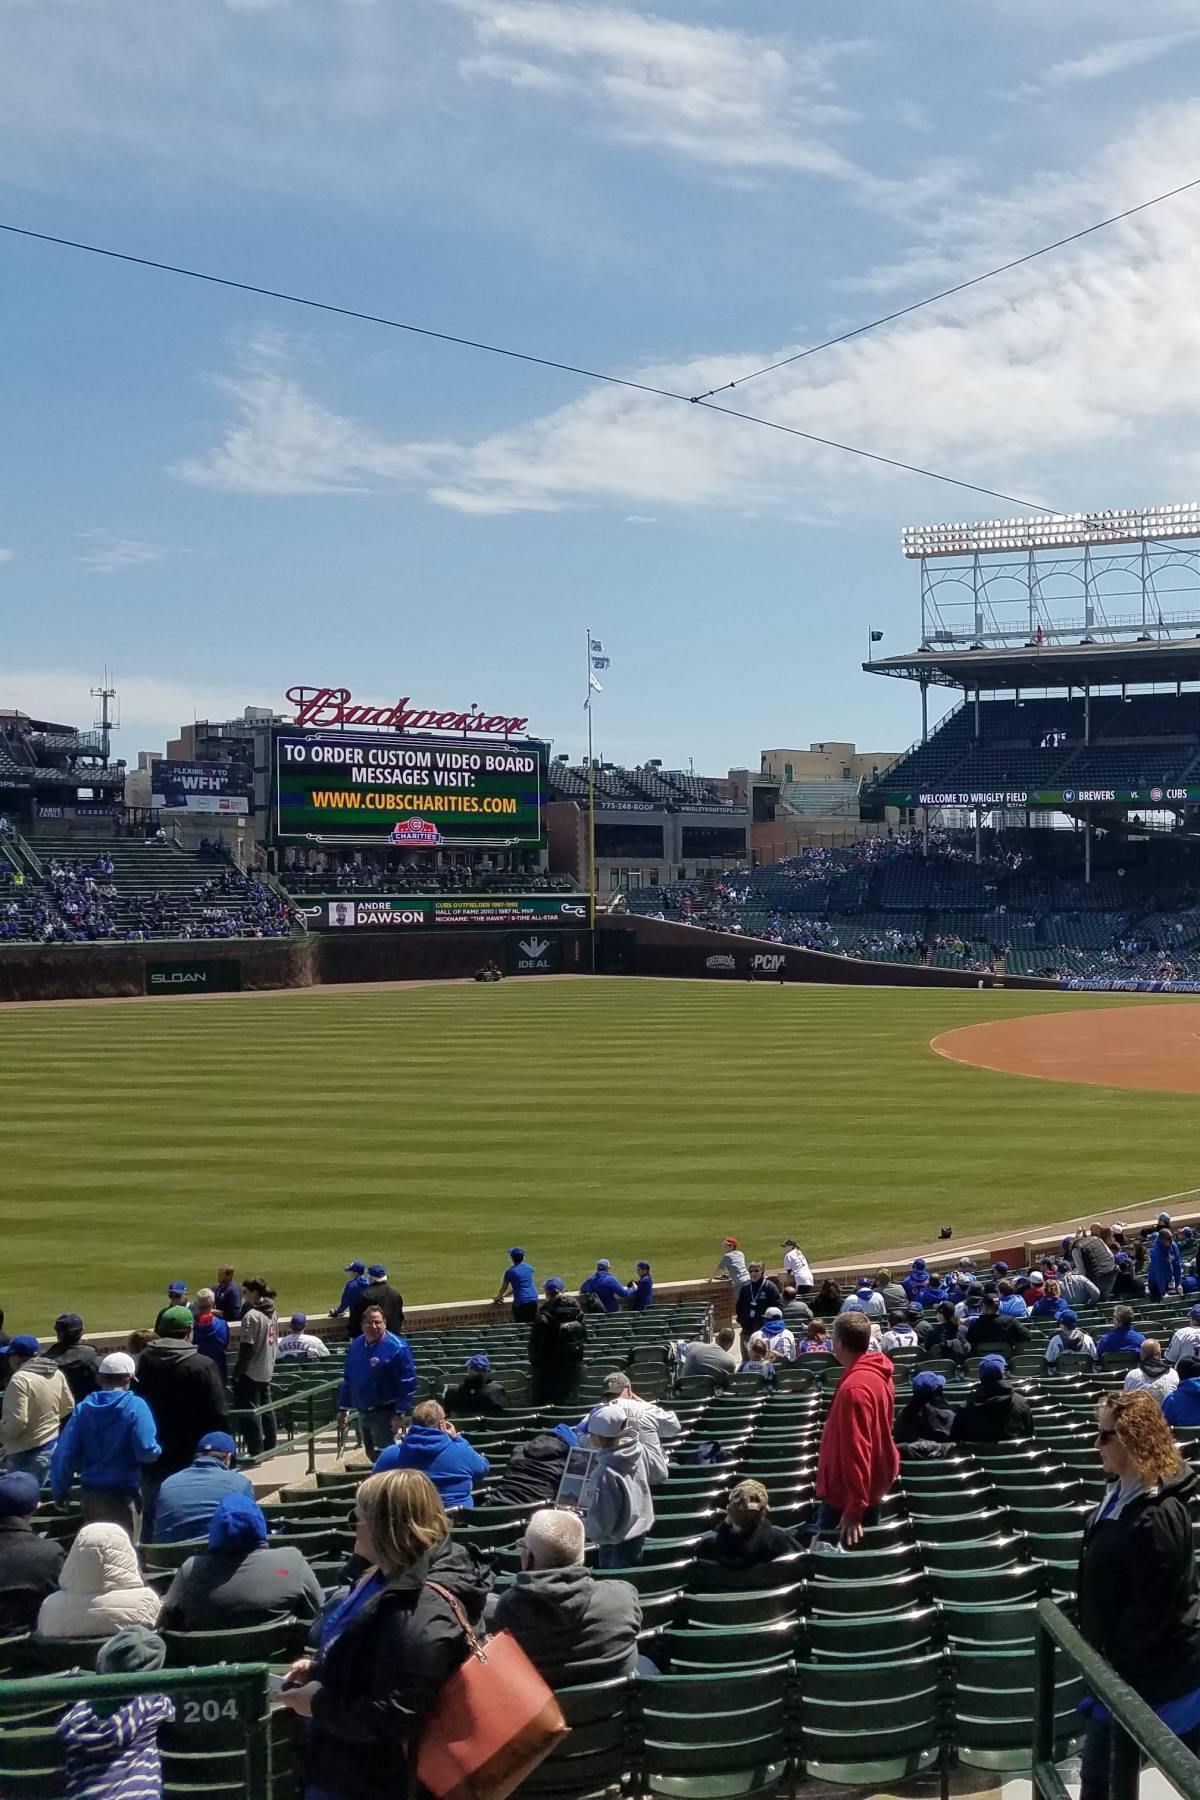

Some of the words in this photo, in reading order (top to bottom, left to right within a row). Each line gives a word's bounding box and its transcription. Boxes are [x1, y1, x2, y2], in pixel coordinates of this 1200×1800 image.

[285, 686, 528, 734] Budweiser
[284, 745, 306, 762] TO
[312, 746, 363, 765] ORDER
[368, 749, 431, 768] CUSTOM
[436, 752, 481, 770] VIDEO
[485, 755, 535, 773] BOARD
[352, 767, 429, 786] MESSAGES
[434, 771, 475, 788] VISIT:
[919, 793, 957, 804] WELCOME
[958, 793, 968, 803] TO
[970, 792, 1004, 803] WRIGLEY
[1006, 792, 1028, 802] FIELD
[1078, 790, 1115, 800] BREWERS
[1166, 789, 1188, 798] CUBS
[312, 791, 517, 813] WWW.CUBSCHARITIES.COM
[395, 833, 437, 842] CHARITIES
[357, 902, 392, 910] ANDRE
[357, 911, 424, 924] DAWSON
[518, 959, 550, 968] IDEAL
[151, 972, 206, 984] SLOAN
[1068, 978, 1112, 991] Reynolds
[1112, 980, 1138, 992] Wrap
[895, 1335, 914, 1347] 17
[184, 1700, 238, 1722] 204
